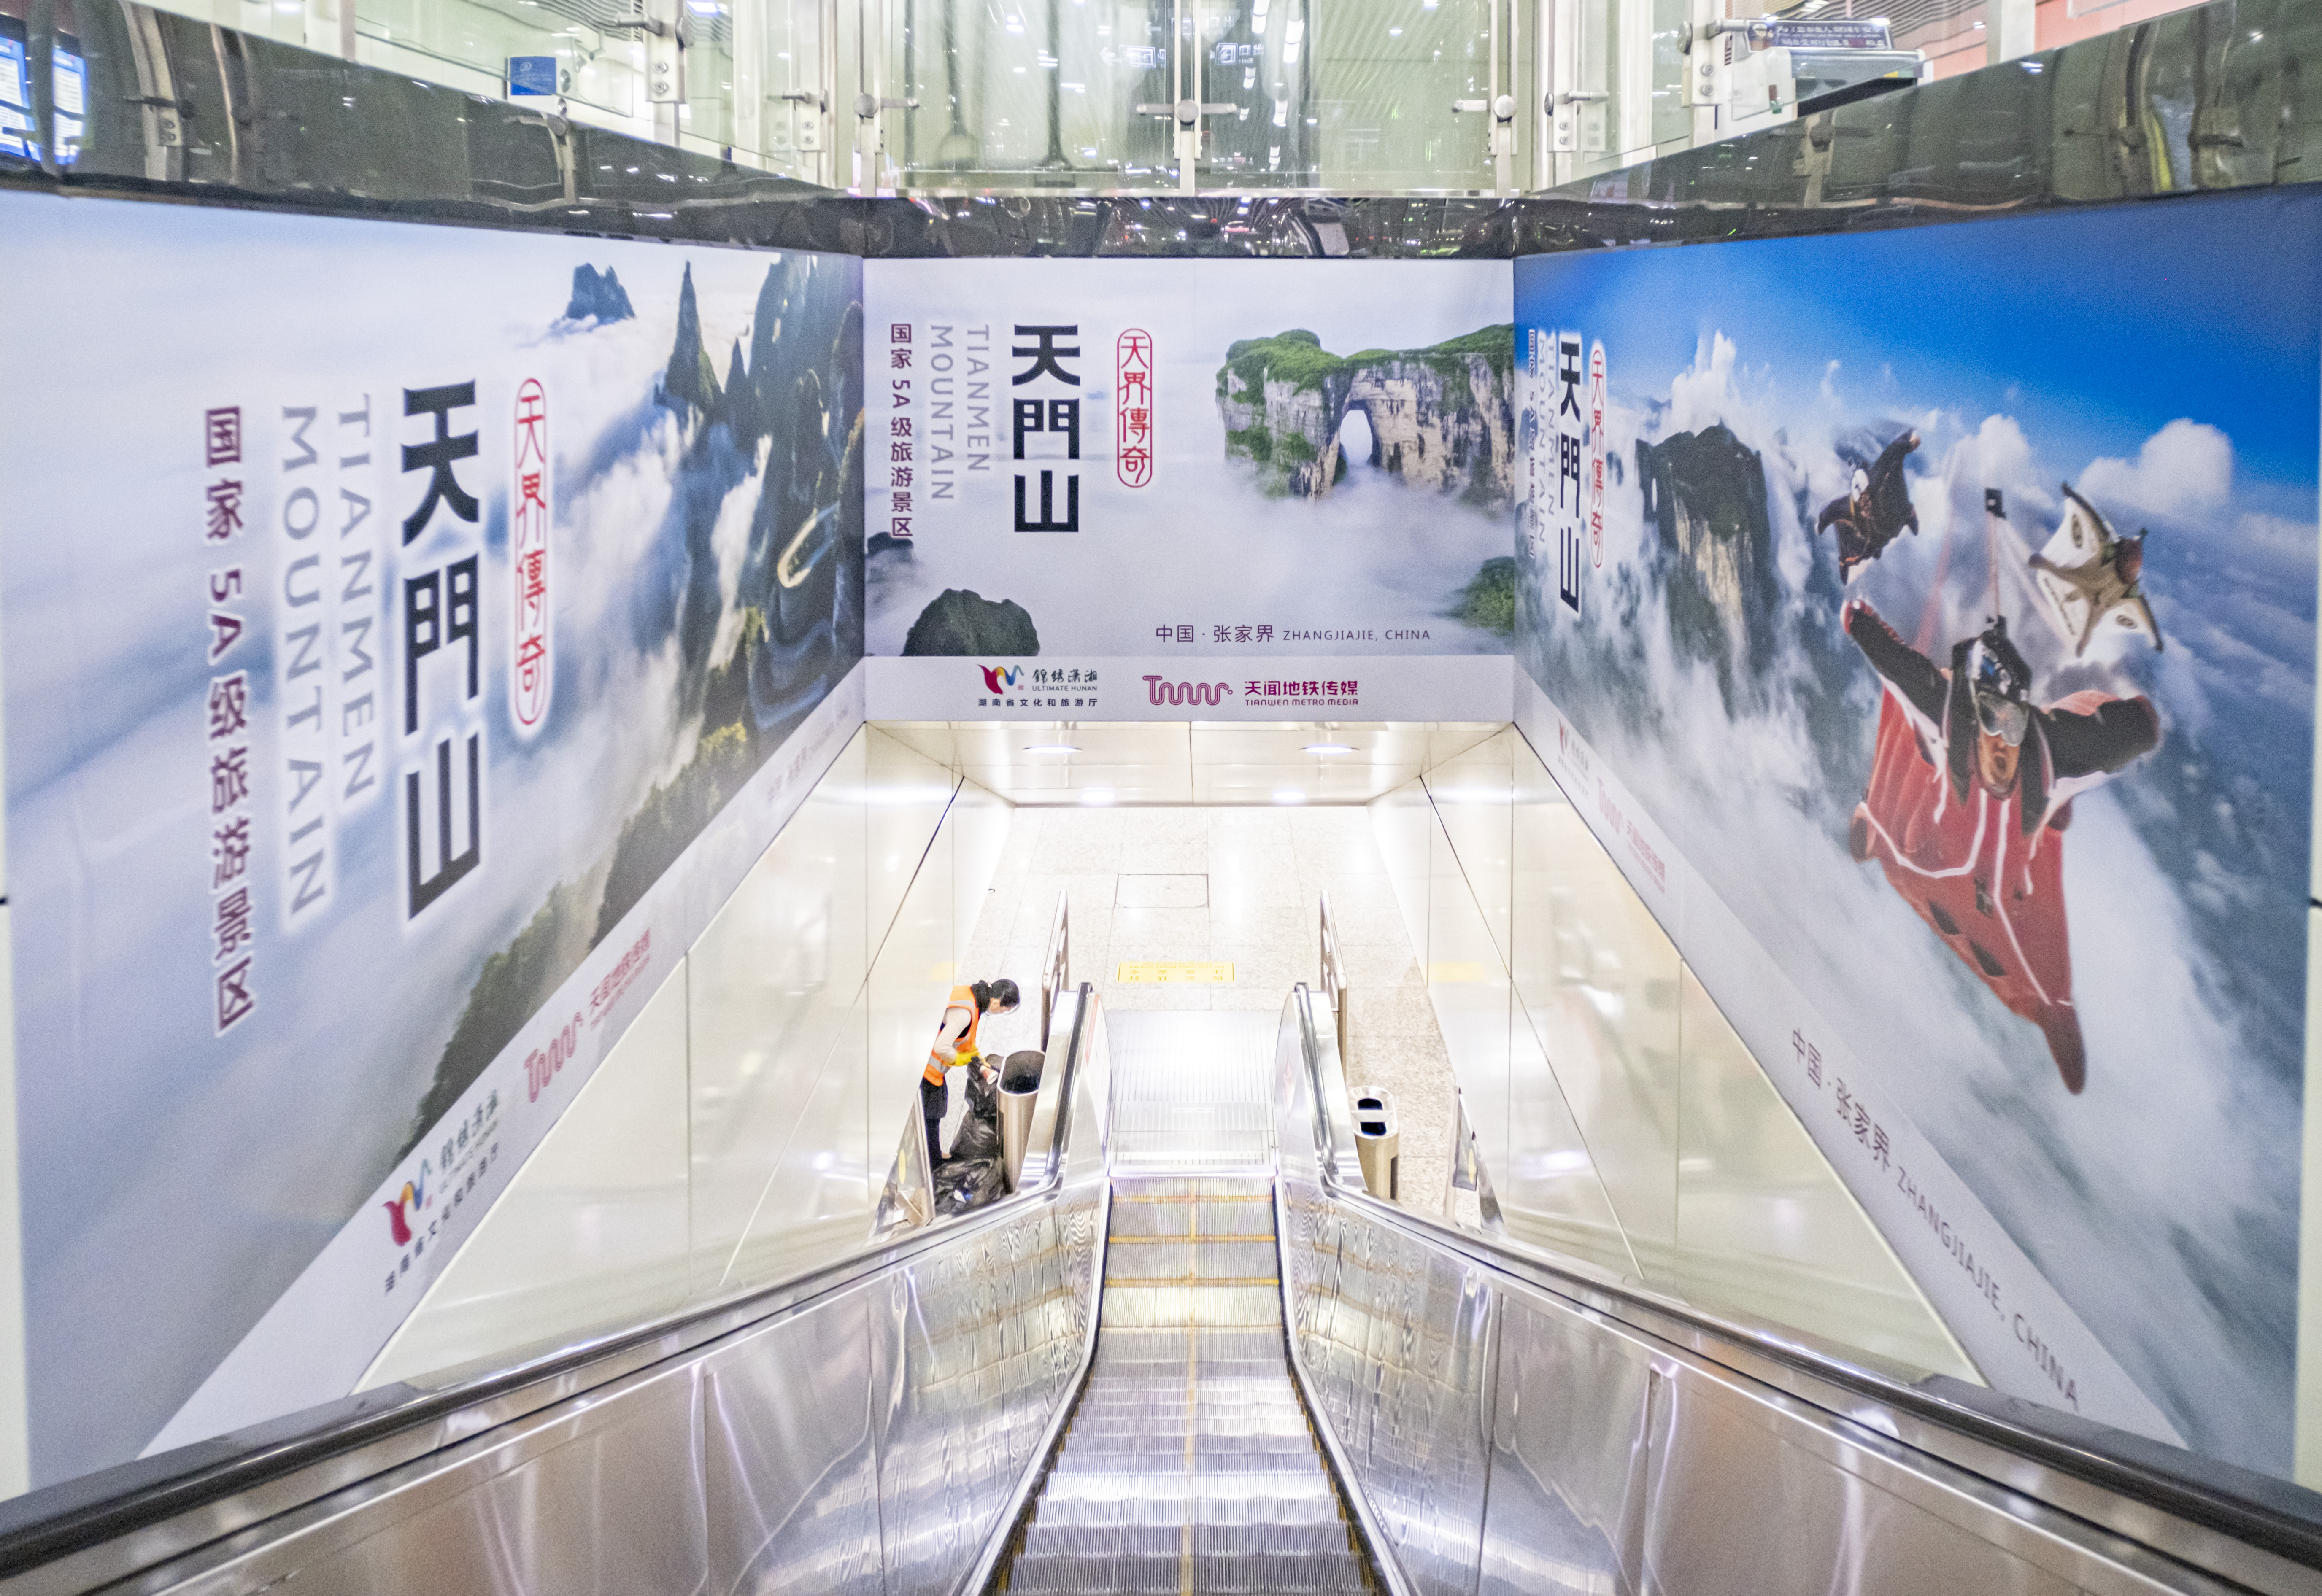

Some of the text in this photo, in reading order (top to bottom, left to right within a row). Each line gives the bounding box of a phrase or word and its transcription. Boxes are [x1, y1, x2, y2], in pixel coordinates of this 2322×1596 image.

[930, 324, 954, 499] MOUNTAIN
[967, 324, 990, 471] TIANMEN
[1012, 323, 1080, 532] 天門山
[281, 405, 325, 915] MOUNTAIN
[339, 393, 374, 802] TIANMEN
[401, 378, 480, 921] 天門山
[1283, 629, 1378, 642] ZHANGJIAJIE,
[1385, 629, 1431, 640] CHINA
[978, 698, 1098, 707] 湖南省文化和旅游厅
[1245, 680, 1358, 696] 天闻地铁传媒
[2013, 1313, 2080, 1411] CHINA
